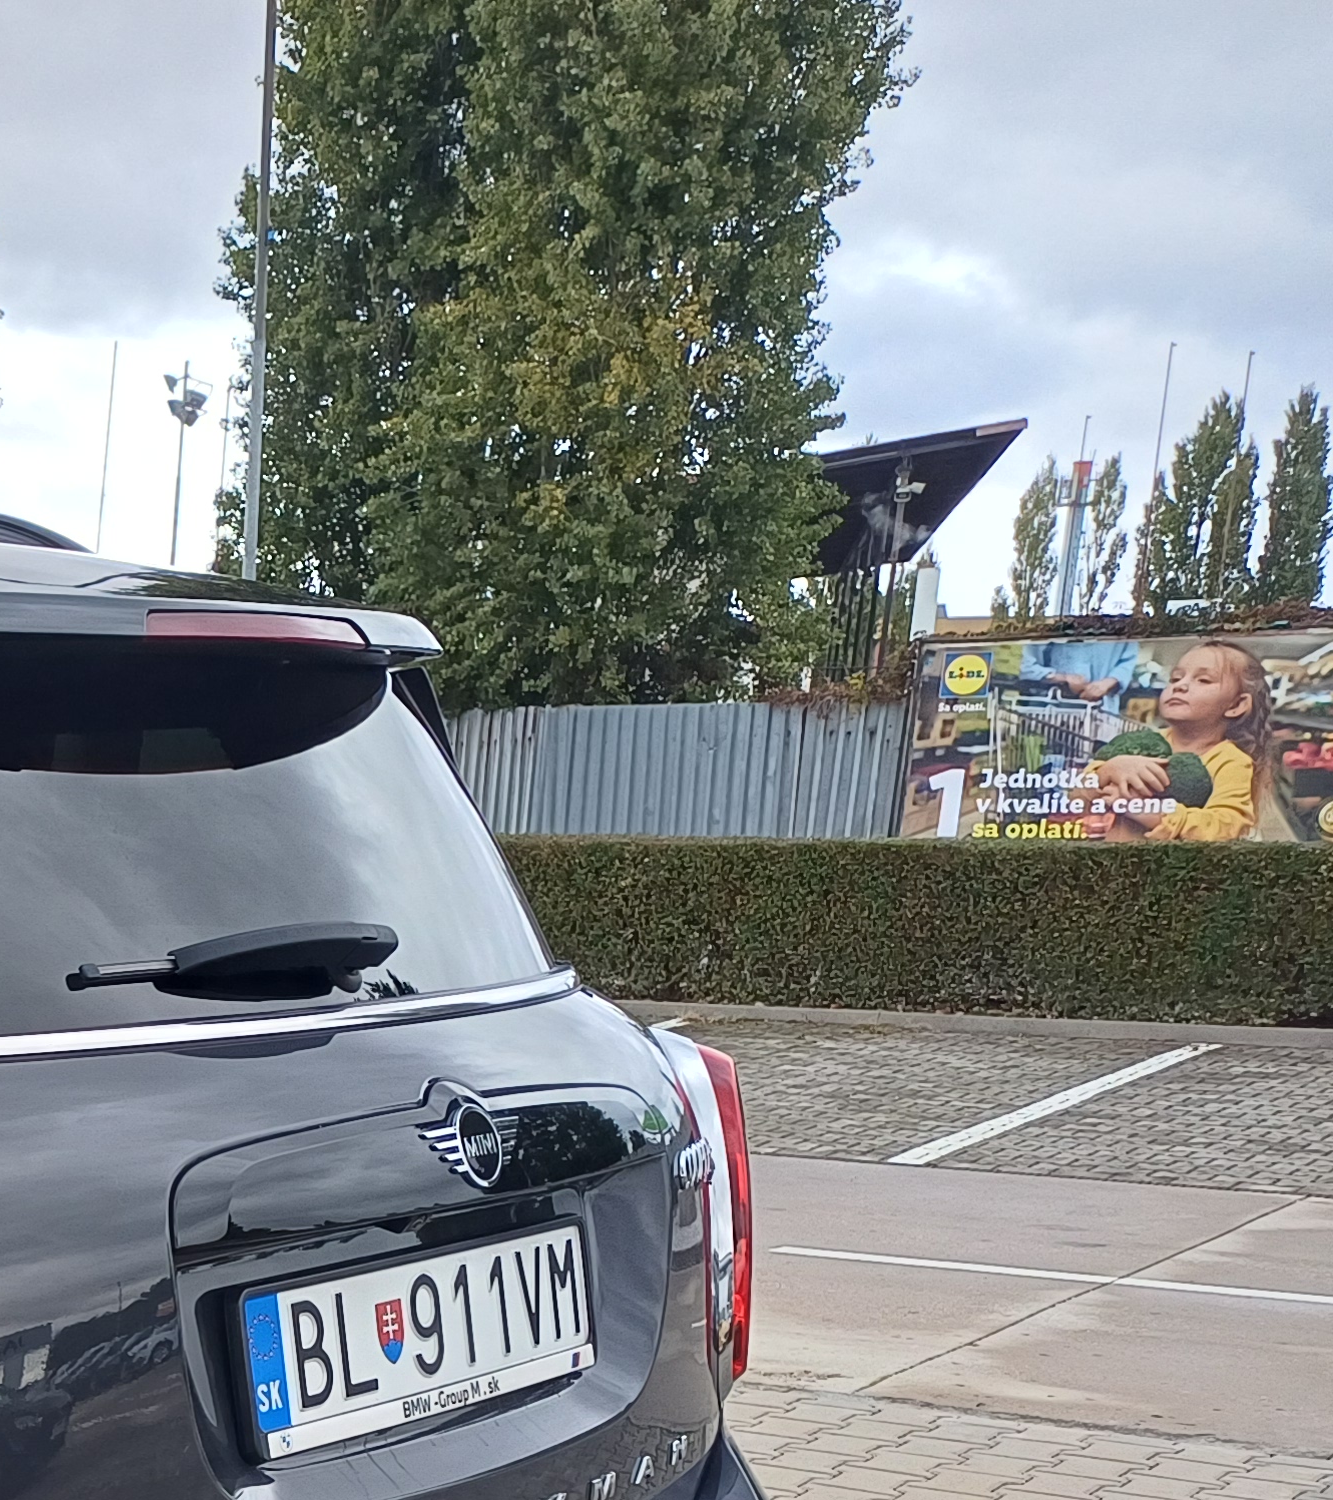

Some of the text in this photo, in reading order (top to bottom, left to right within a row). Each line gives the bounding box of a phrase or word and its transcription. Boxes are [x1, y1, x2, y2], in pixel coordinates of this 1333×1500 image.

[979, 769, 1099, 789] Jednotka
[928, 768, 965, 838] 1
[976, 793, 1177, 814] v kvalite a cene
[971, 823, 998, 838] sa
[463, 1132, 497, 1157] MINI
[291, 1238, 581, 1408] BL 911VM
[257, 1380, 283, 1412] SK
